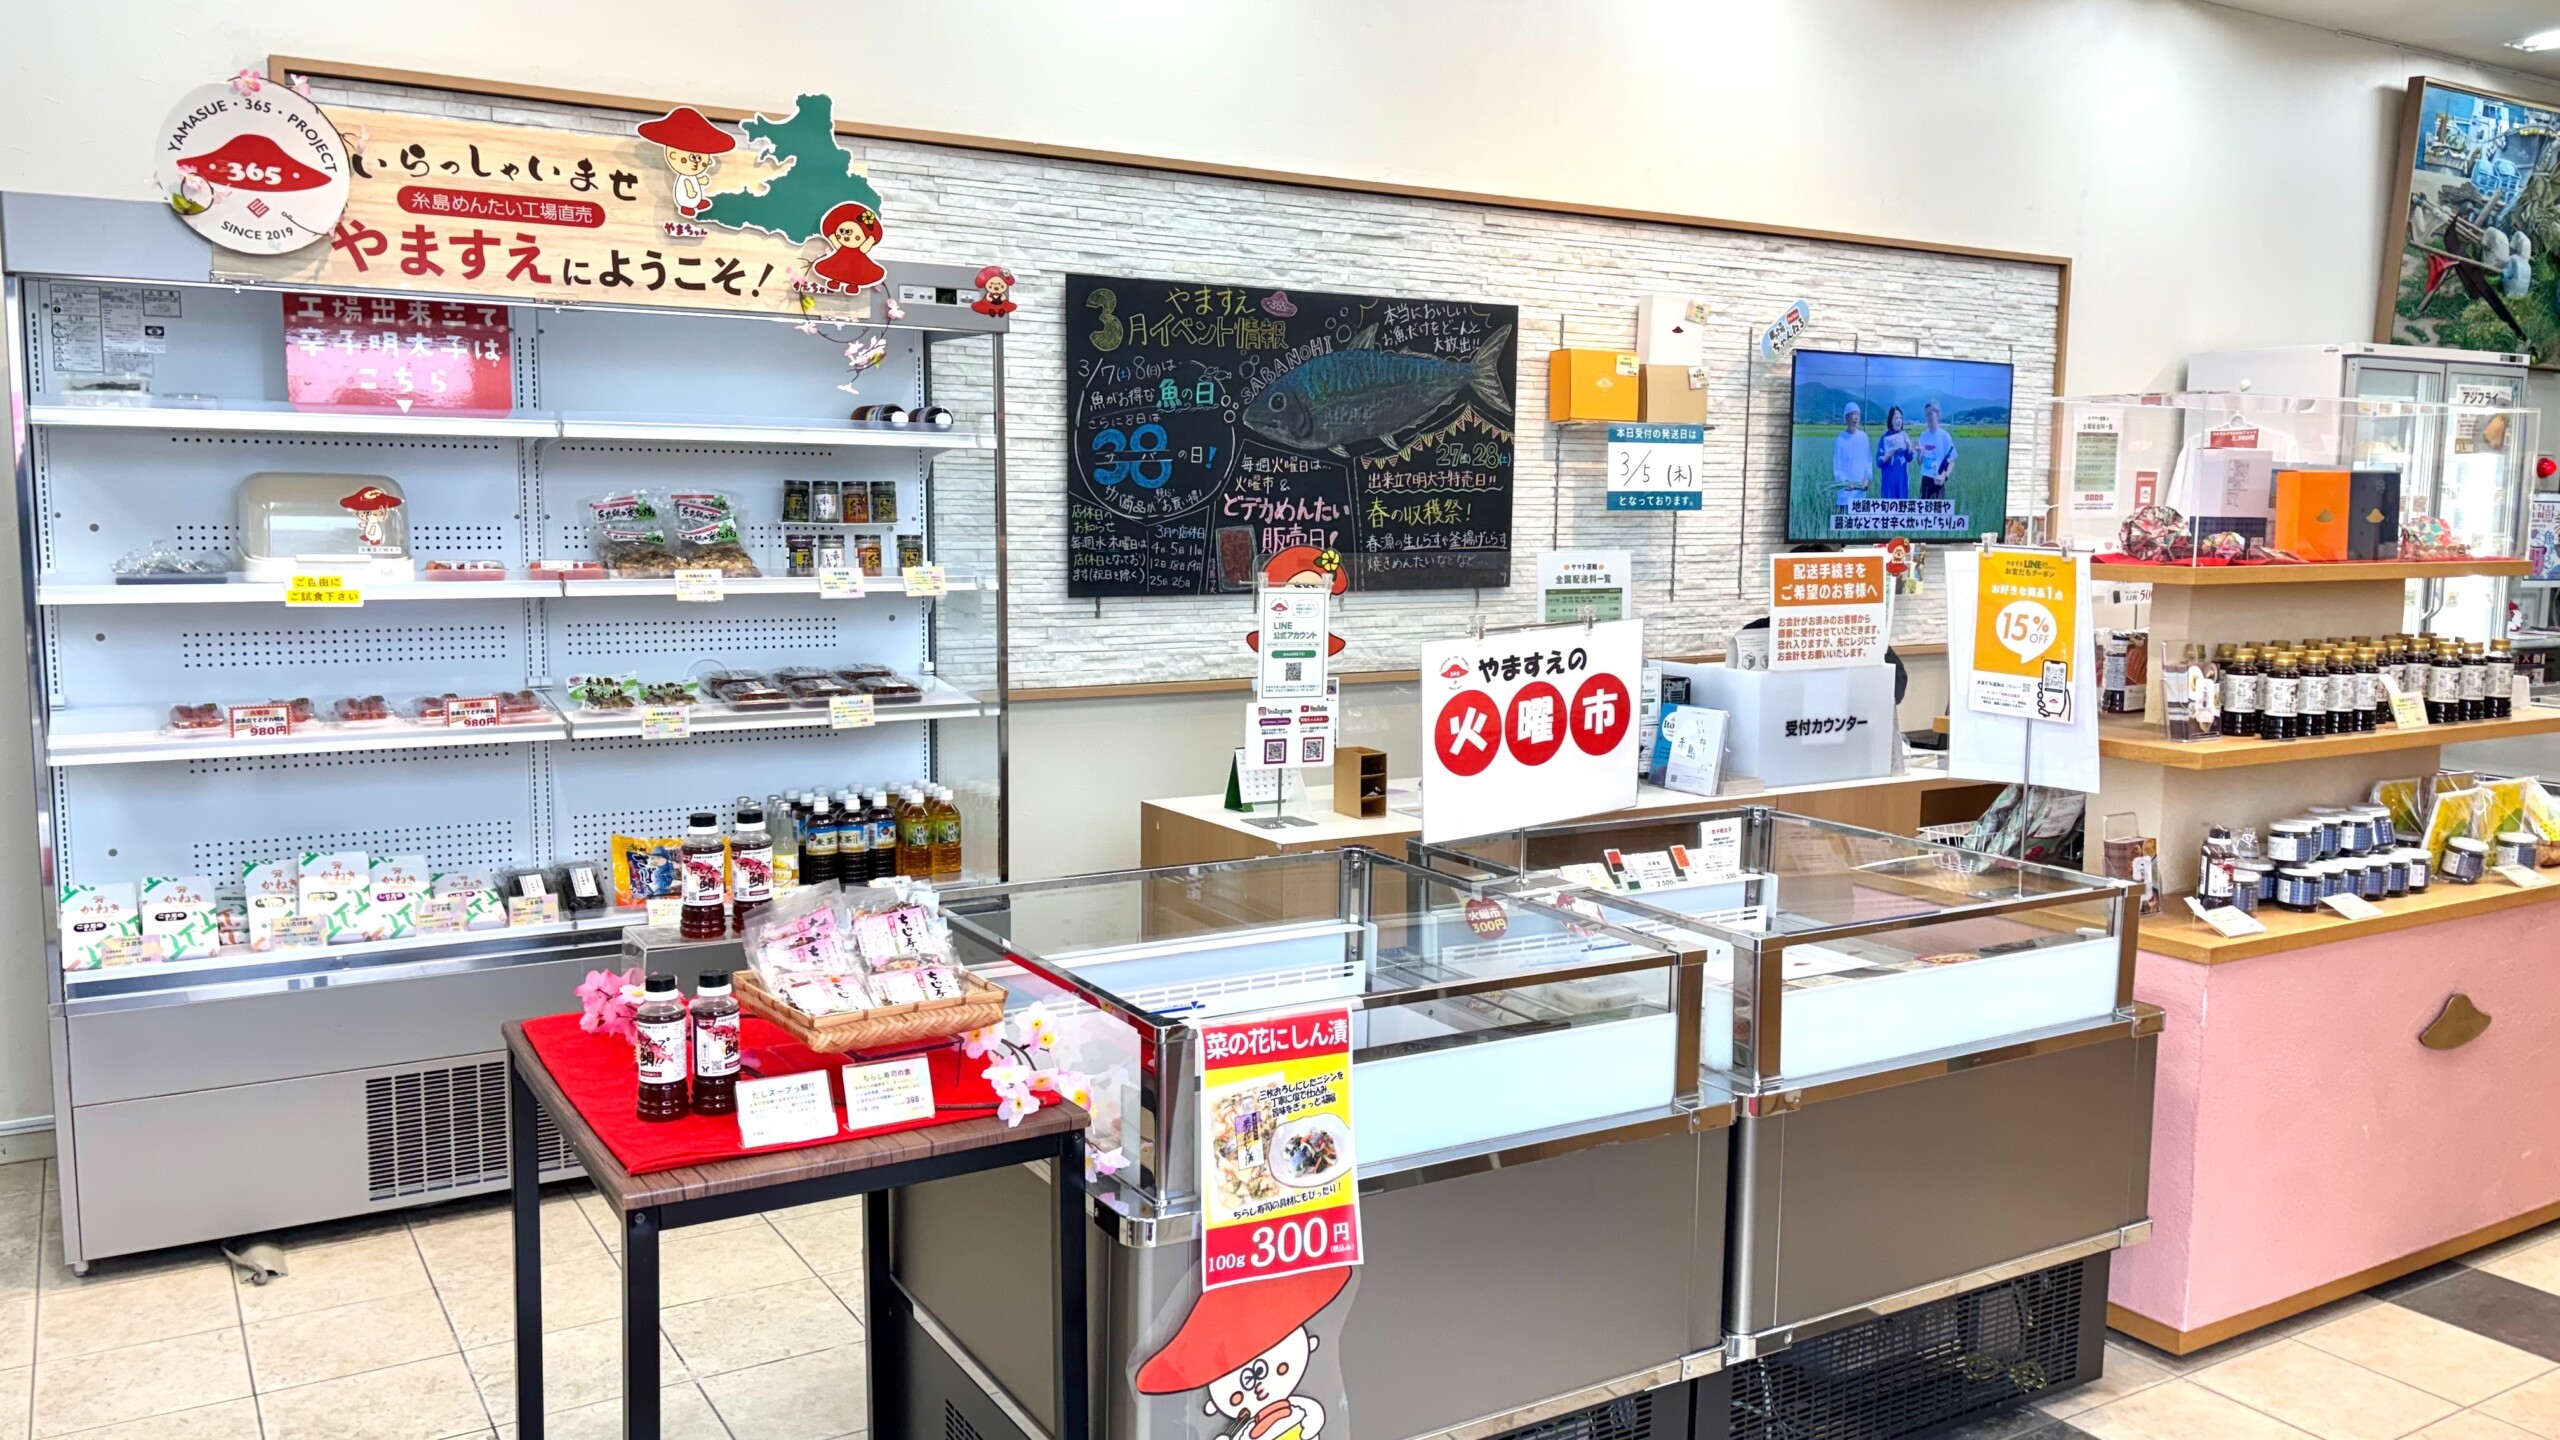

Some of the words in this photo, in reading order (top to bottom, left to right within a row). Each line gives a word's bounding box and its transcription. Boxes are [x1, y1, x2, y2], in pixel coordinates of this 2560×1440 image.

[168, 99, 229, 152] YAMASUE
[244, 98, 272, 113] 365
[287, 113, 338, 173] PROJECT
[226, 161, 282, 185] 365
[352, 143, 639, 201] いらっしゃいませ
[411, 190, 594, 224] 糸島めんたい工場直売
[221, 220, 262, 240] SINCE
[266, 226, 294, 241] 2019
[664, 221, 708, 237] やまちゃん
[1165, 285, 1256, 316] やますえ
[298, 295, 498, 327] 工場出来立て
[1085, 288, 1289, 351] 3月イベント情報
[1383, 303, 1467, 326] 本当においしい
[1381, 320, 1481, 347] お魚だけをどーんと
[297, 327, 501, 362] 辛子明太子は
[358, 367, 448, 393] こちら
[1090, 387, 1155, 412] 魚がお得な
[1156, 377, 1215, 409] 魚の日
[2462, 391, 2499, 405] アジフライ
[1088, 412, 1162, 430] さらに8日は
[1615, 427, 1697, 441] 本日受付の発送日は
[1620, 449, 1653, 487] 3/5
[1666, 463, 1693, 488] (木)
[1224, 492, 1350, 524] どデカめんたい
[1618, 494, 1695, 507] となっております。
[1851, 500, 1952, 514] 地鶏や旬の野菜を砂糖や
[1071, 504, 1113, 521] 店休日の
[1073, 520, 1116, 534] お知らせ
[1834, 515, 1966, 530] 醤油などで甘辛く炊いた「ちり」の
[1155, 523, 1205, 540] 3月の店休日
[1073, 553, 1147, 567] 店休日となっており
[2023, 560, 2042, 569] LINE
[1555, 574, 1612, 585] 全国配送料一覧
[1793, 563, 1867, 581] 配送手続きを
[2005, 568, 2056, 578] お友だちクーポン
[296, 577, 342, 588] ご自由に
[290, 591, 360, 602] ご試食下さい
[1780, 583, 1879, 601] ご希望のお客様へ
[1991, 584, 2064, 601] お好きな商品1点
[1273, 621, 1293, 630] LINE
[1778, 614, 1872, 628] お会計がお済みのお客様から
[1273, 631, 1318, 640] 公式アカウント
[1777, 636, 1878, 650] 恐れ入りますが、先にレジにて
[2029, 633, 2050, 645] OFF
[1478, 647, 1588, 683] やますえの
[1267, 708, 1293, 716] Instagram
[1310, 704, 1328, 712] YouTube
[463, 717, 496, 728] 980円
[1449, 687, 1619, 756] 火曜市
[1785, 714, 1869, 738] 受付カウンター
[250, 725, 287, 736] 980円
[1471, 919, 1507, 934] 300円
[1206, 1019, 1348, 1061] 菜の花にしん漬
[1260, 1071, 1344, 1101] 三枚おろしにしたニシンを
[1208, 1252, 1246, 1273] 100g
